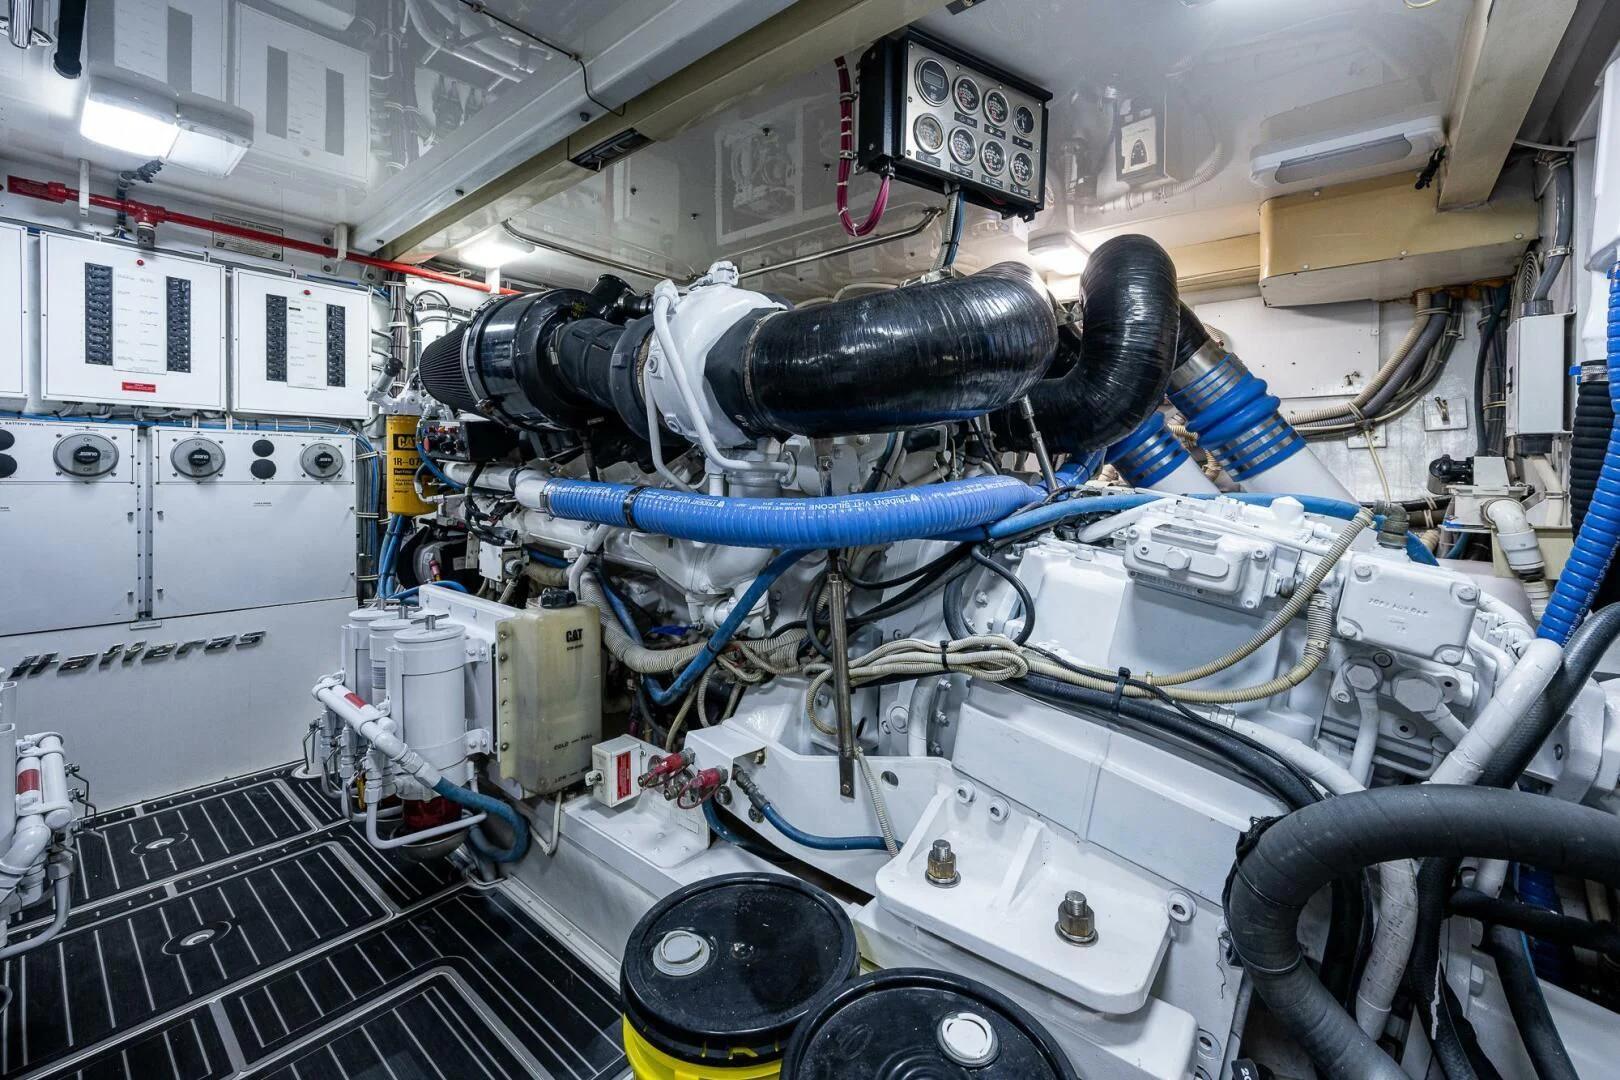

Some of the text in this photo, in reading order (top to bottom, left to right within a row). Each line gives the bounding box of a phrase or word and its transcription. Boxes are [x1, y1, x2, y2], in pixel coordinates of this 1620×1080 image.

[808, 501, 850, 511] SILICONE
[873, 496, 908, 506] TRIDENT
[566, 628, 583, 643] CAT
